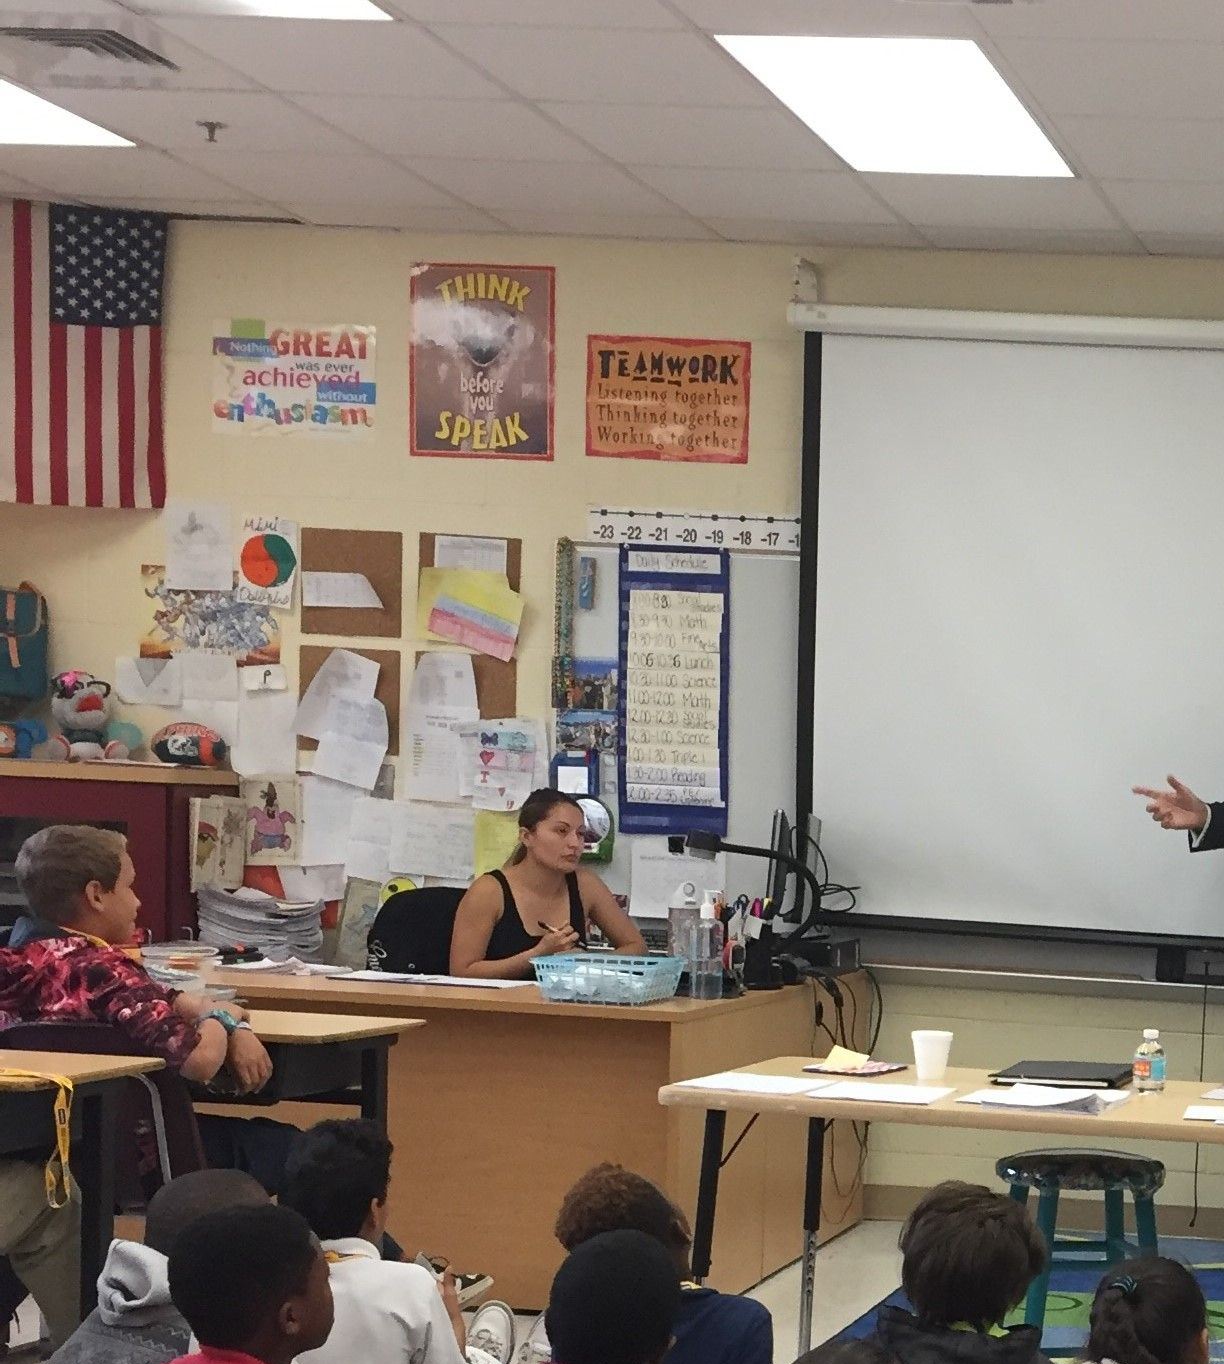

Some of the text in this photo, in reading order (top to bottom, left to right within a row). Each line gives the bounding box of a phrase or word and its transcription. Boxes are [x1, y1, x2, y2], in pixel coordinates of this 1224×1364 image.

[435, 273, 532, 311] THINK
[270, 329, 367, 359] GREAT
[242, 368, 360, 389] achieved
[295, 361, 355, 373] was ever
[598, 350, 740, 386] TEAMWORK
[460, 371, 504, 393] before
[317, 389, 368, 402] without
[469, 395, 494, 414] you
[598, 383, 738, 409] Listening together
[596, 404, 738, 430] Thinking together
[435, 411, 529, 449] SPEAK
[597, 426, 737, 452] Working together
[593, 525, 615, 539] -23
[621, 526, 642, 540] -22
[648, 527, 668, 541] -21
[675, 528, 698, 543] -20
[705, 530, 724, 544] -19
[733, 531, 752, 545] -18
[760, 532, 779, 546] -17
[681, 691, 711, 709] Math
